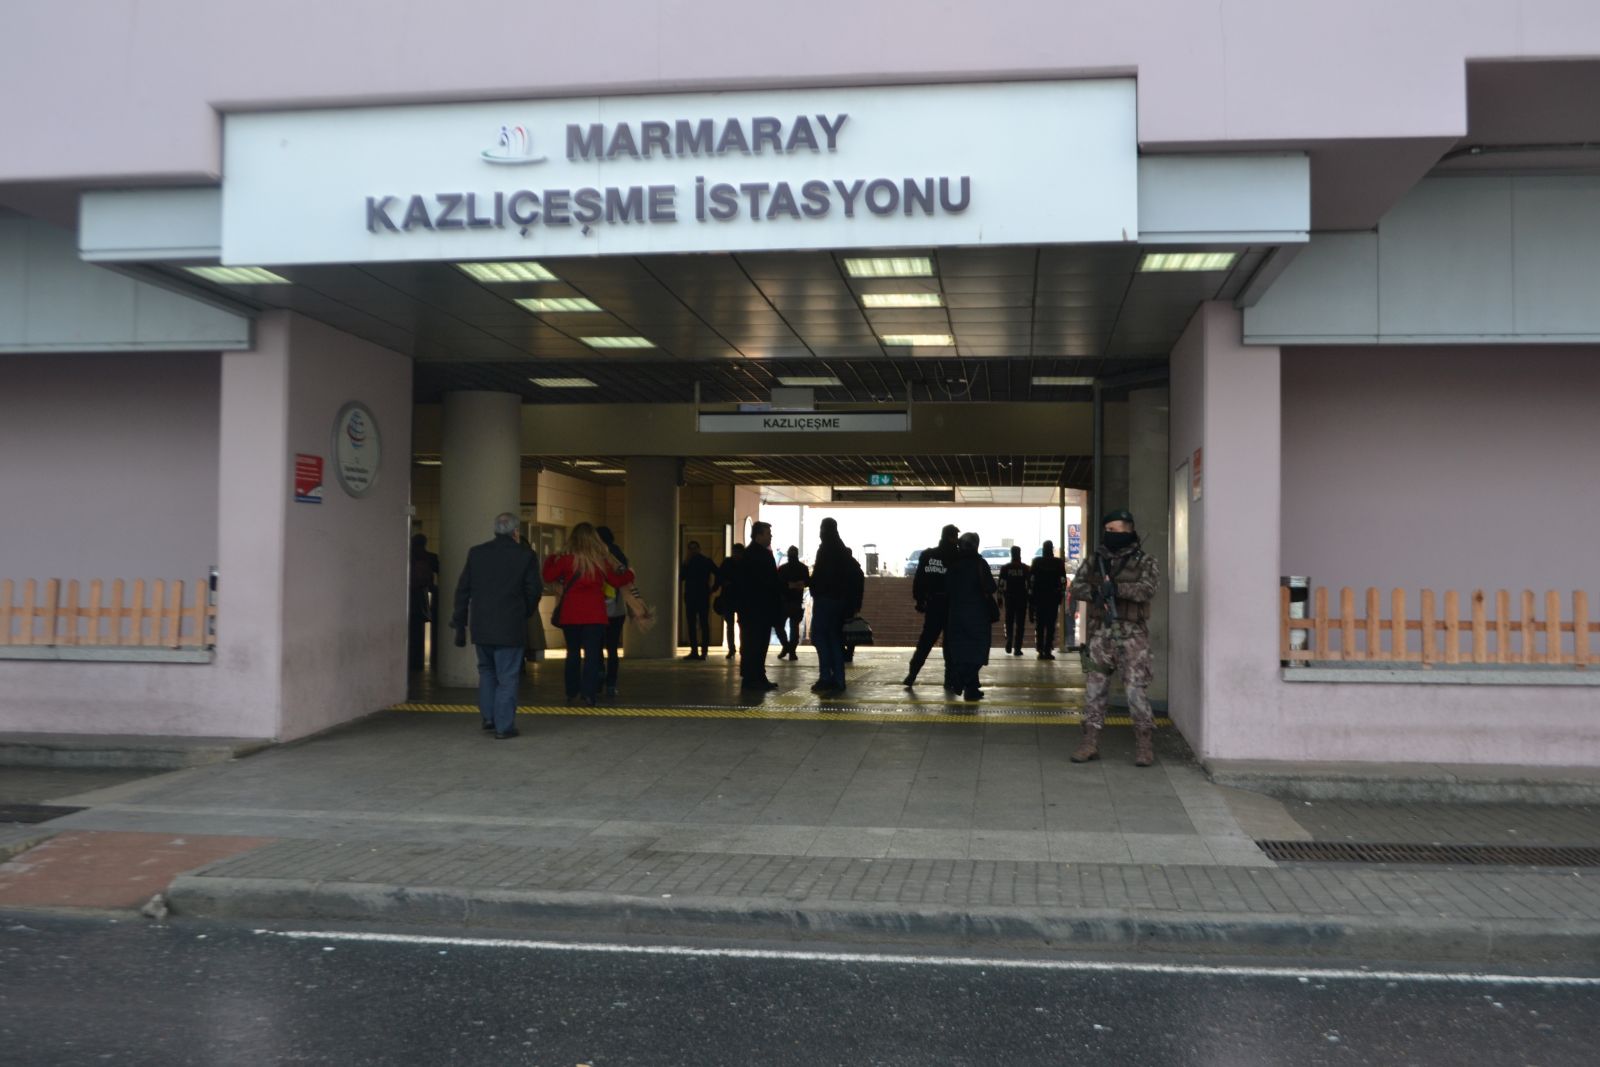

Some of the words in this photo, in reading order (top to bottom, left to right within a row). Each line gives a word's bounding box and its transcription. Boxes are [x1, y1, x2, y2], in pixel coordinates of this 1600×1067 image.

[566, 113, 848, 161] MARMARAY
[365, 184, 676, 237] KAZLIÇEŞME
[695, 175, 971, 223] İSTASYONU
[763, 418, 840, 430] KAZLIÇEŞME
[928, 557, 943, 567] ÖZEL
